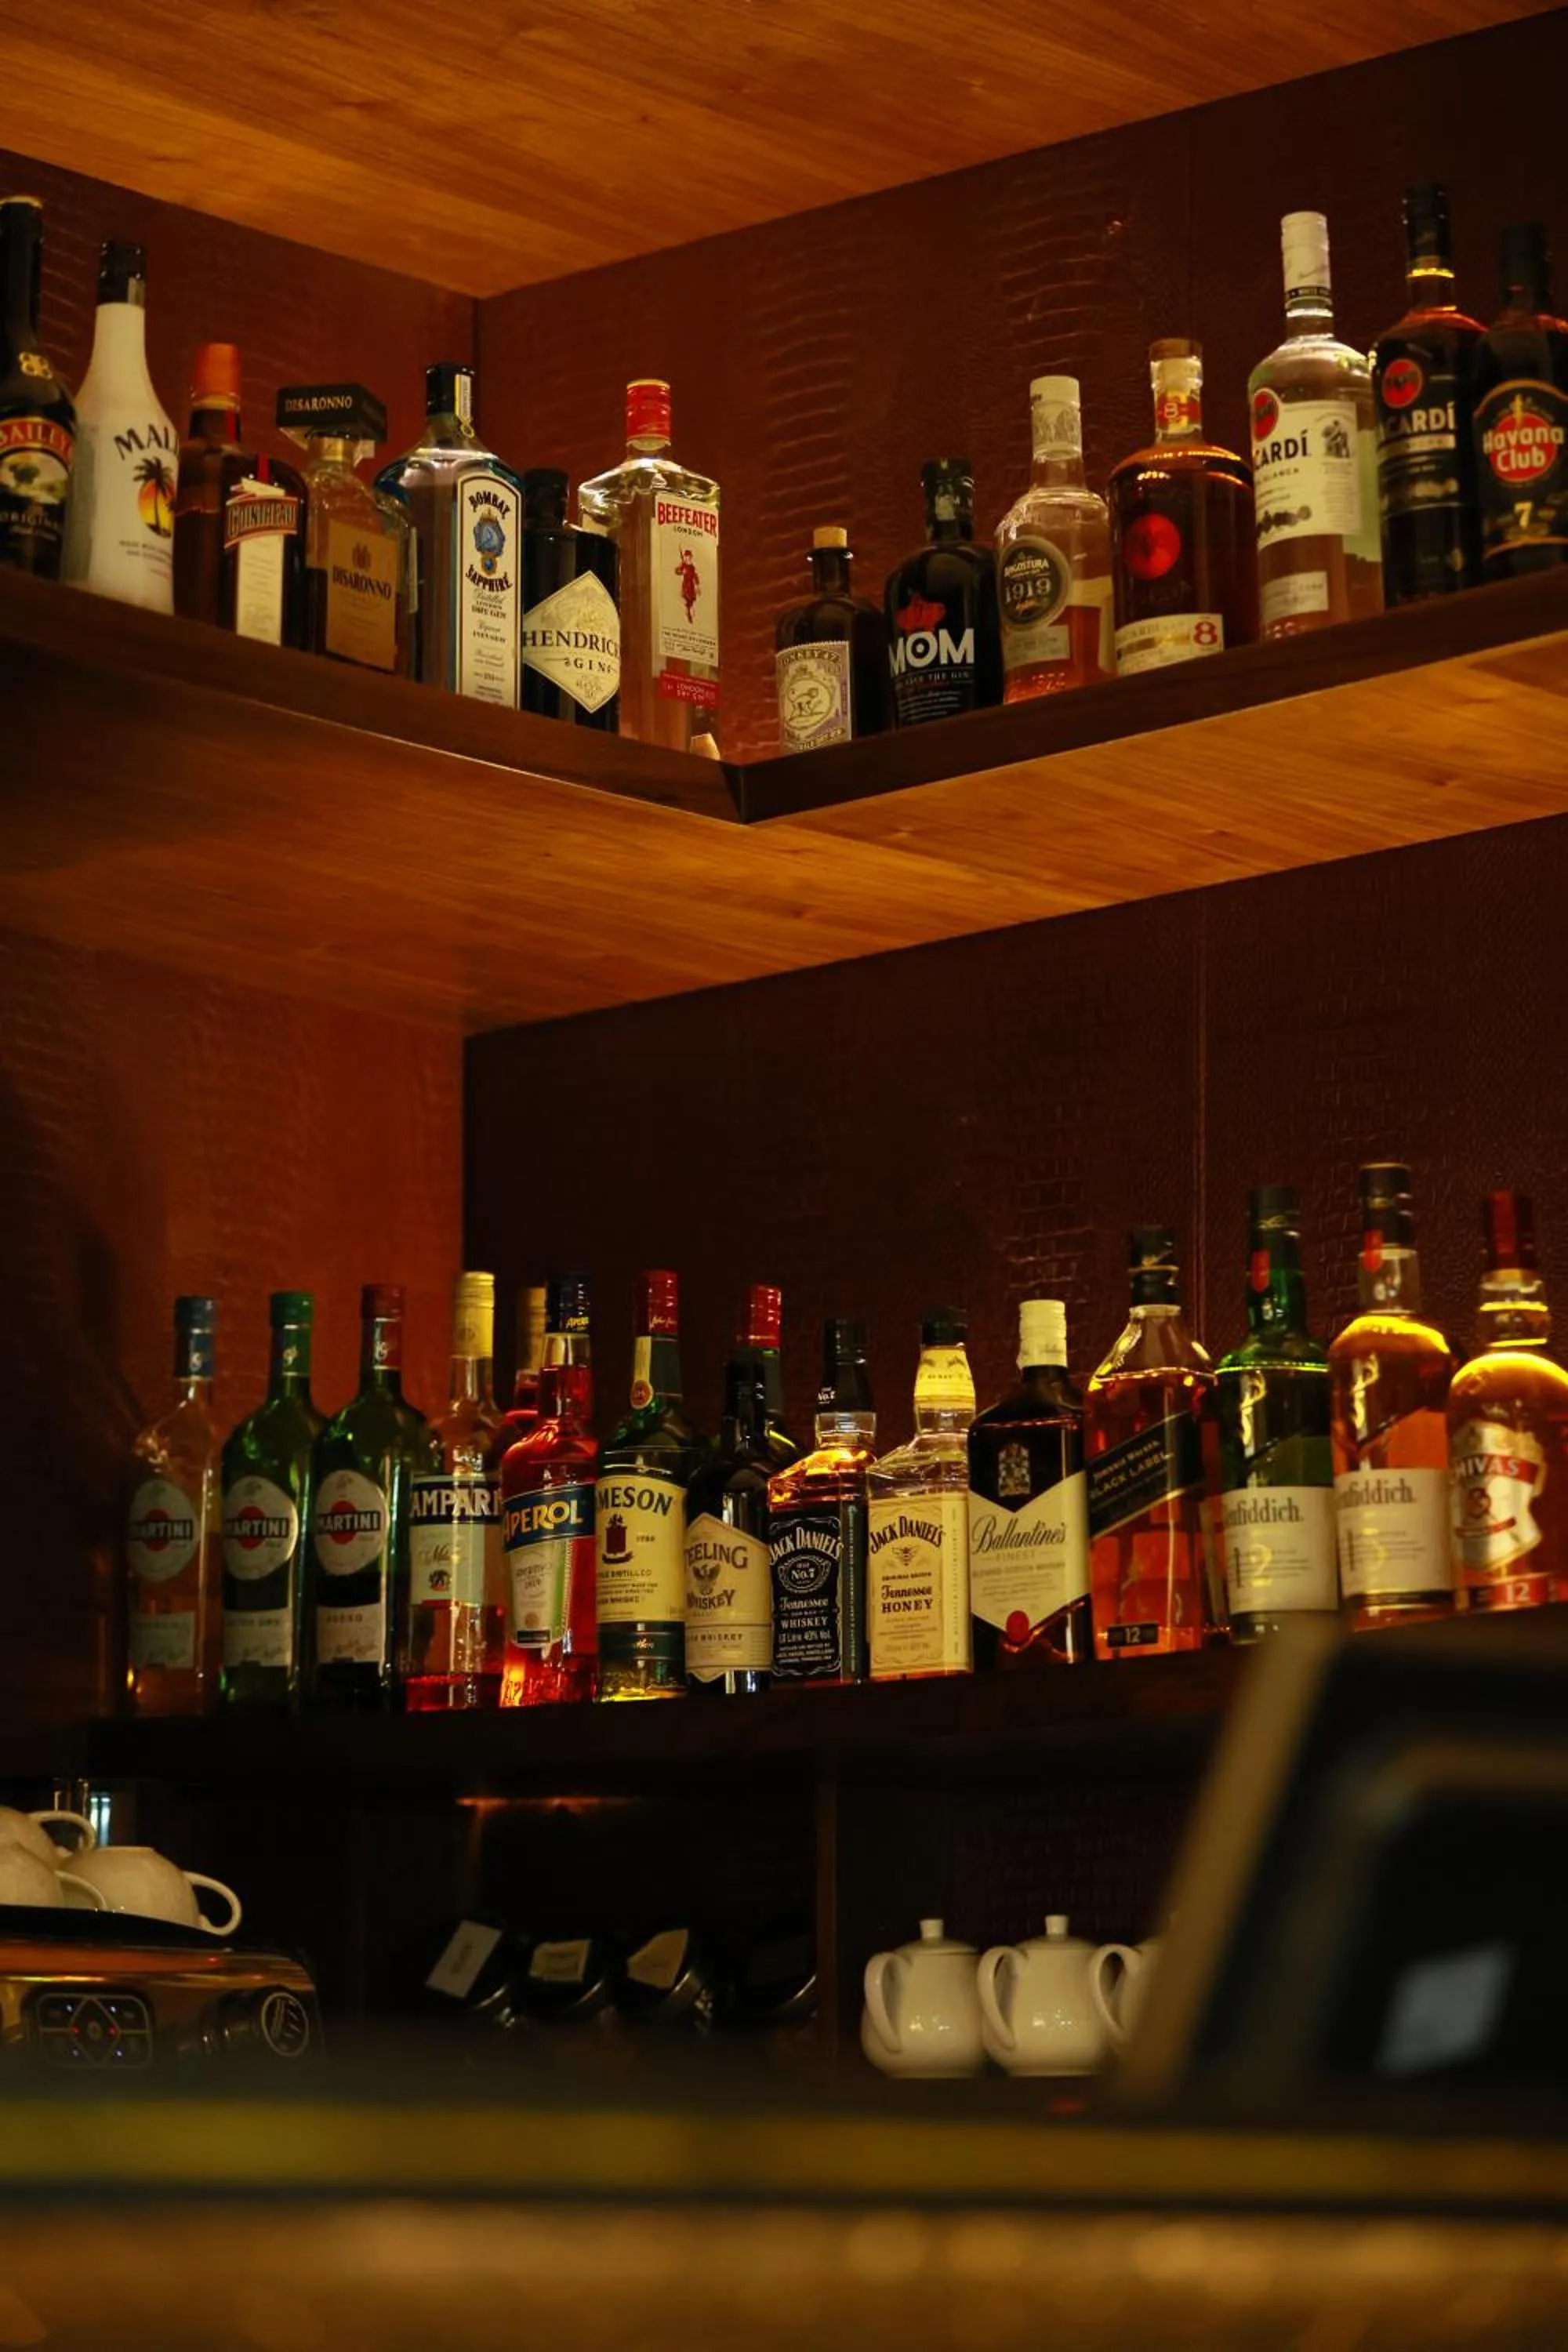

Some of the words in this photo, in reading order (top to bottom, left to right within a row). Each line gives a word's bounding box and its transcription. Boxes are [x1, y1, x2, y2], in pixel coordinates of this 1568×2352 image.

[285, 395, 352, 412] DISARONNO
[1483, 427, 1563, 455] Havana
[1497, 446, 1546, 472] Club
[468, 490, 510, 520] BOMBAY
[1514, 502, 1532, 528] 7
[658, 501, 717, 539] BEEFEATER
[332, 564, 392, 601] DISARONNO
[465, 564, 514, 593] SAPPHIRE
[1005, 578, 1051, 604] 1919
[1192, 621, 1218, 646] 8
[573, 658, 607, 673] GIN
[888, 628, 975, 678] MOM
[504, 1499, 585, 1544] APEROL
[870, 1522, 898, 1555] JACK
[898, 1515, 942, 1548] DANIEL'S
[971, 1515, 1067, 1555] Ballantine's
[770, 1534, 796, 1566] JACK
[686, 1588, 736, 1610] WHISKEY
[881, 1584, 933, 1600] Tennessee
[1504, 1582, 1530, 1602] 12
[882, 1599, 934, 1613] HONEY
[780, 1615, 829, 1629] WHISKEY
